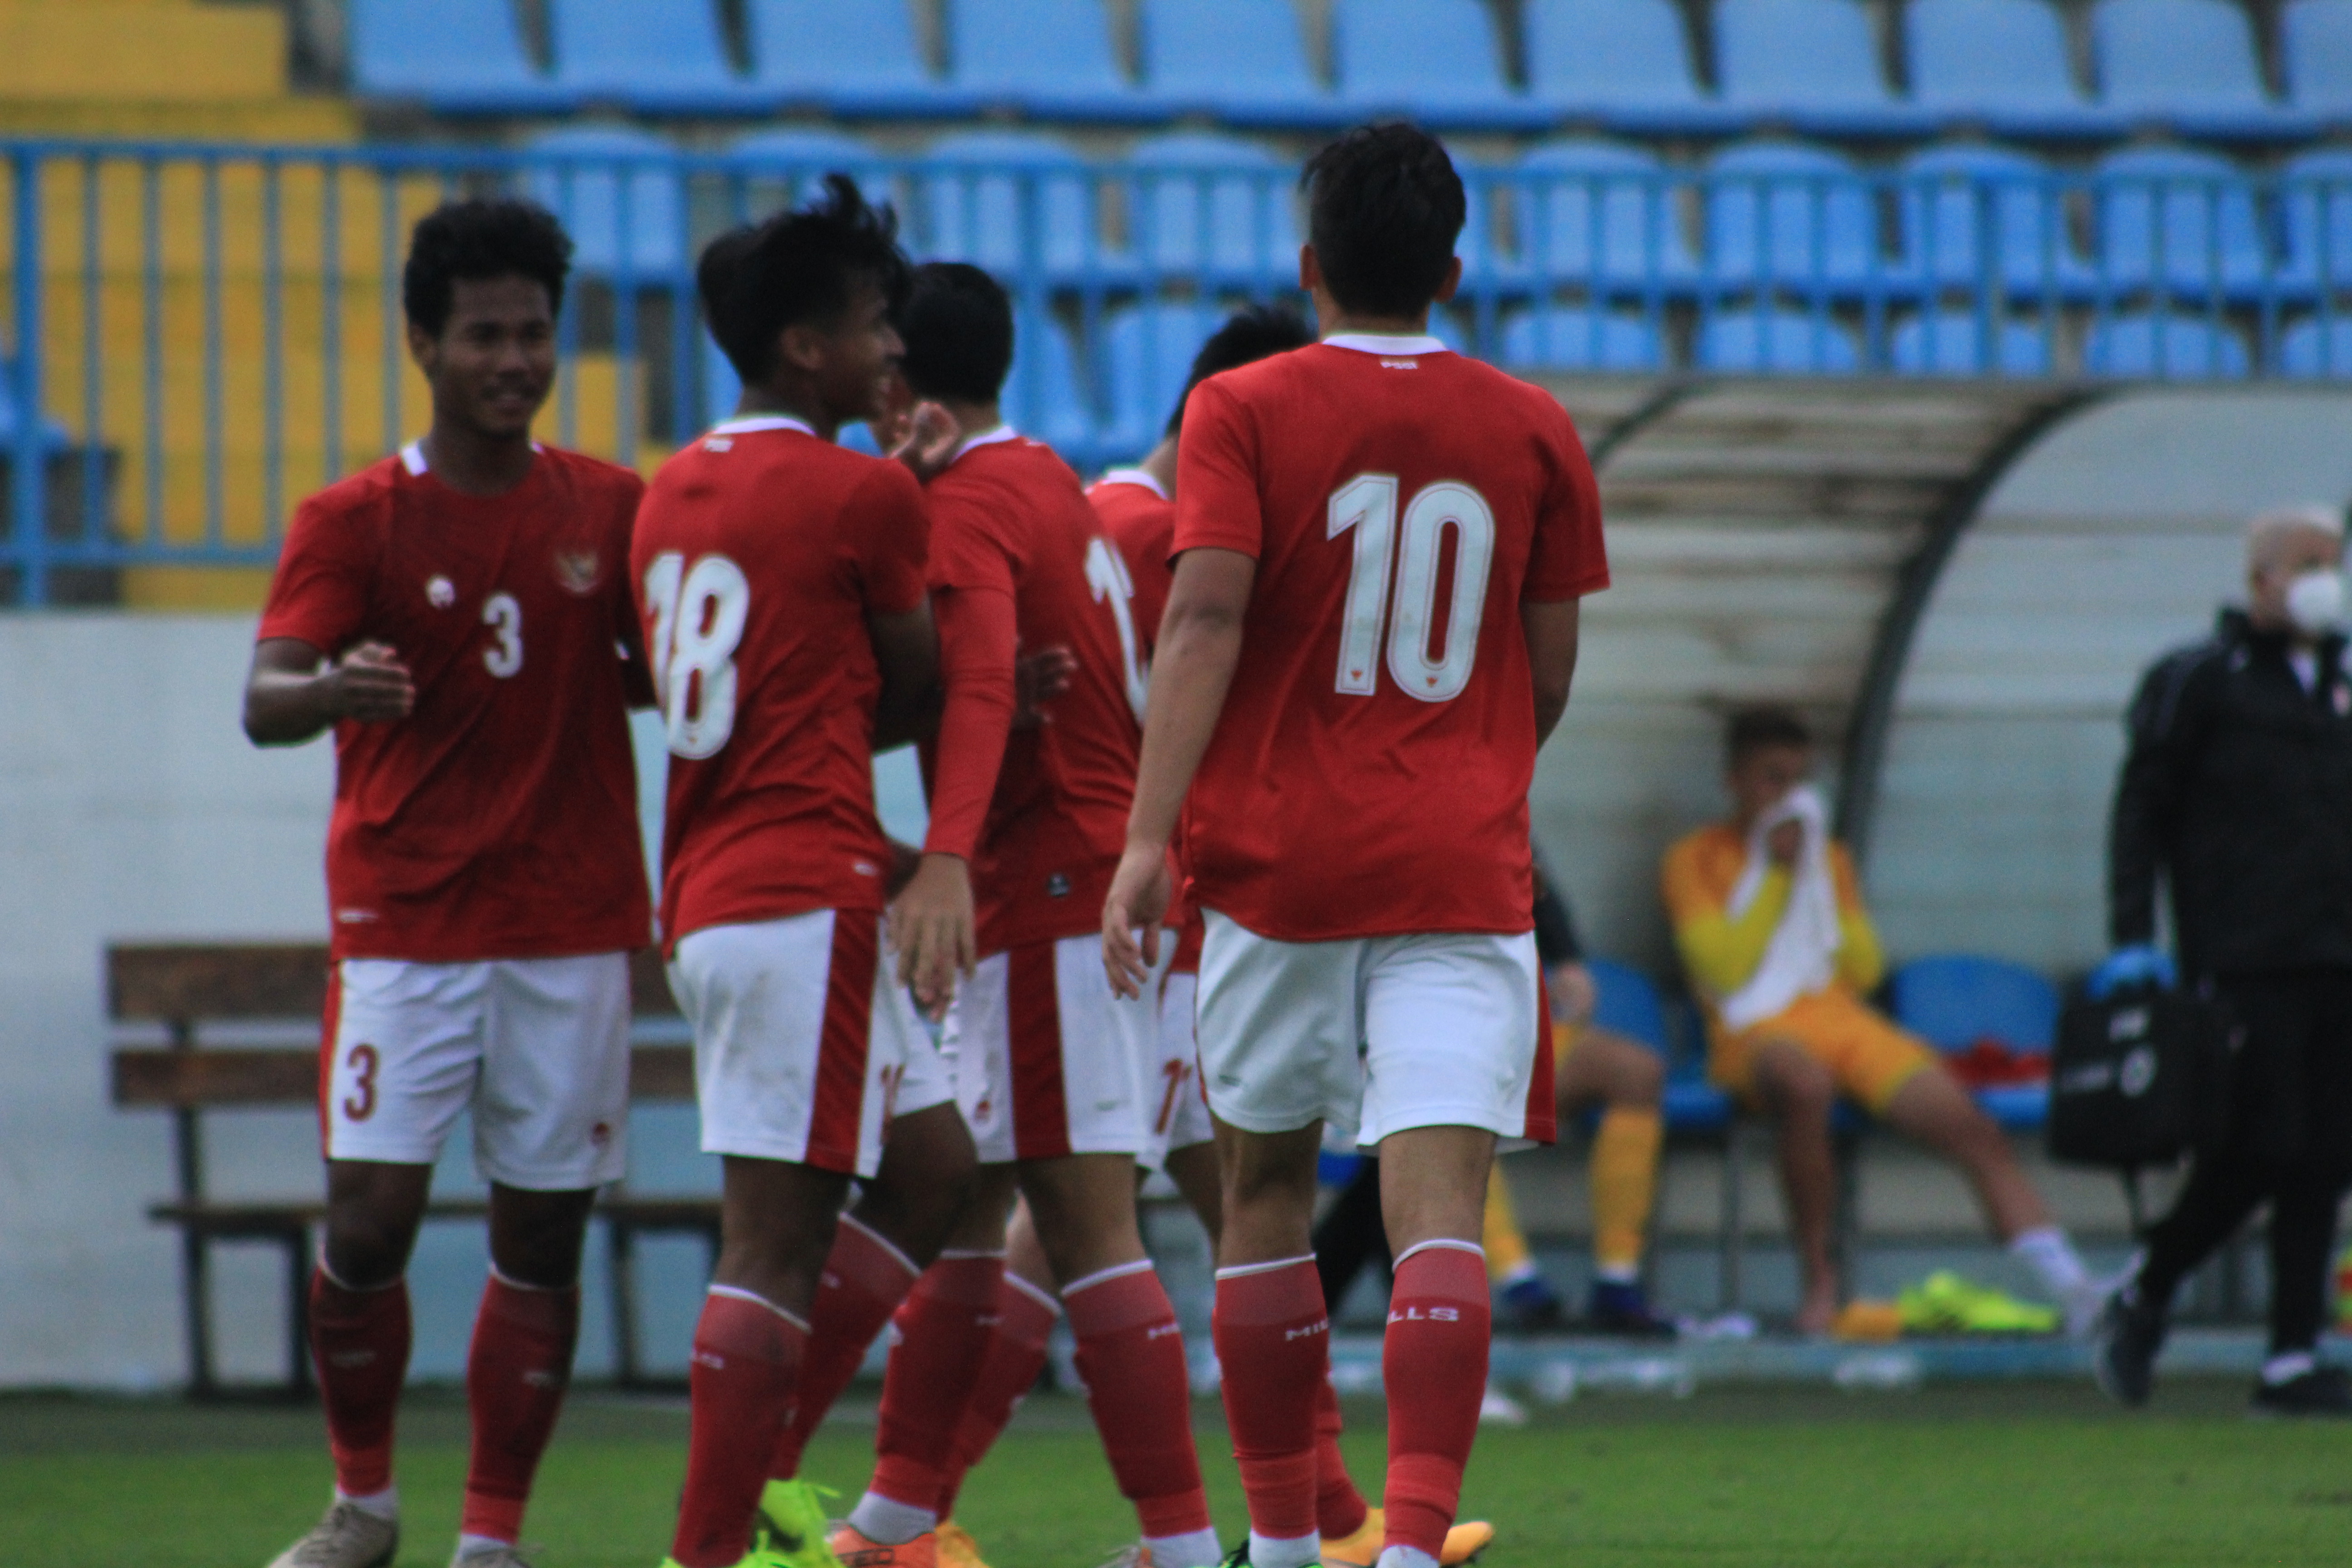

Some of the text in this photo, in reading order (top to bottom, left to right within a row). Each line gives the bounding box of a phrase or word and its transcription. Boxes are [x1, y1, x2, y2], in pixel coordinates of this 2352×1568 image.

[481, 592, 524, 678] 3
[644, 554, 750, 760] 18
[1327, 474, 1496, 702] 10
[344, 1043, 381, 1122] 3
